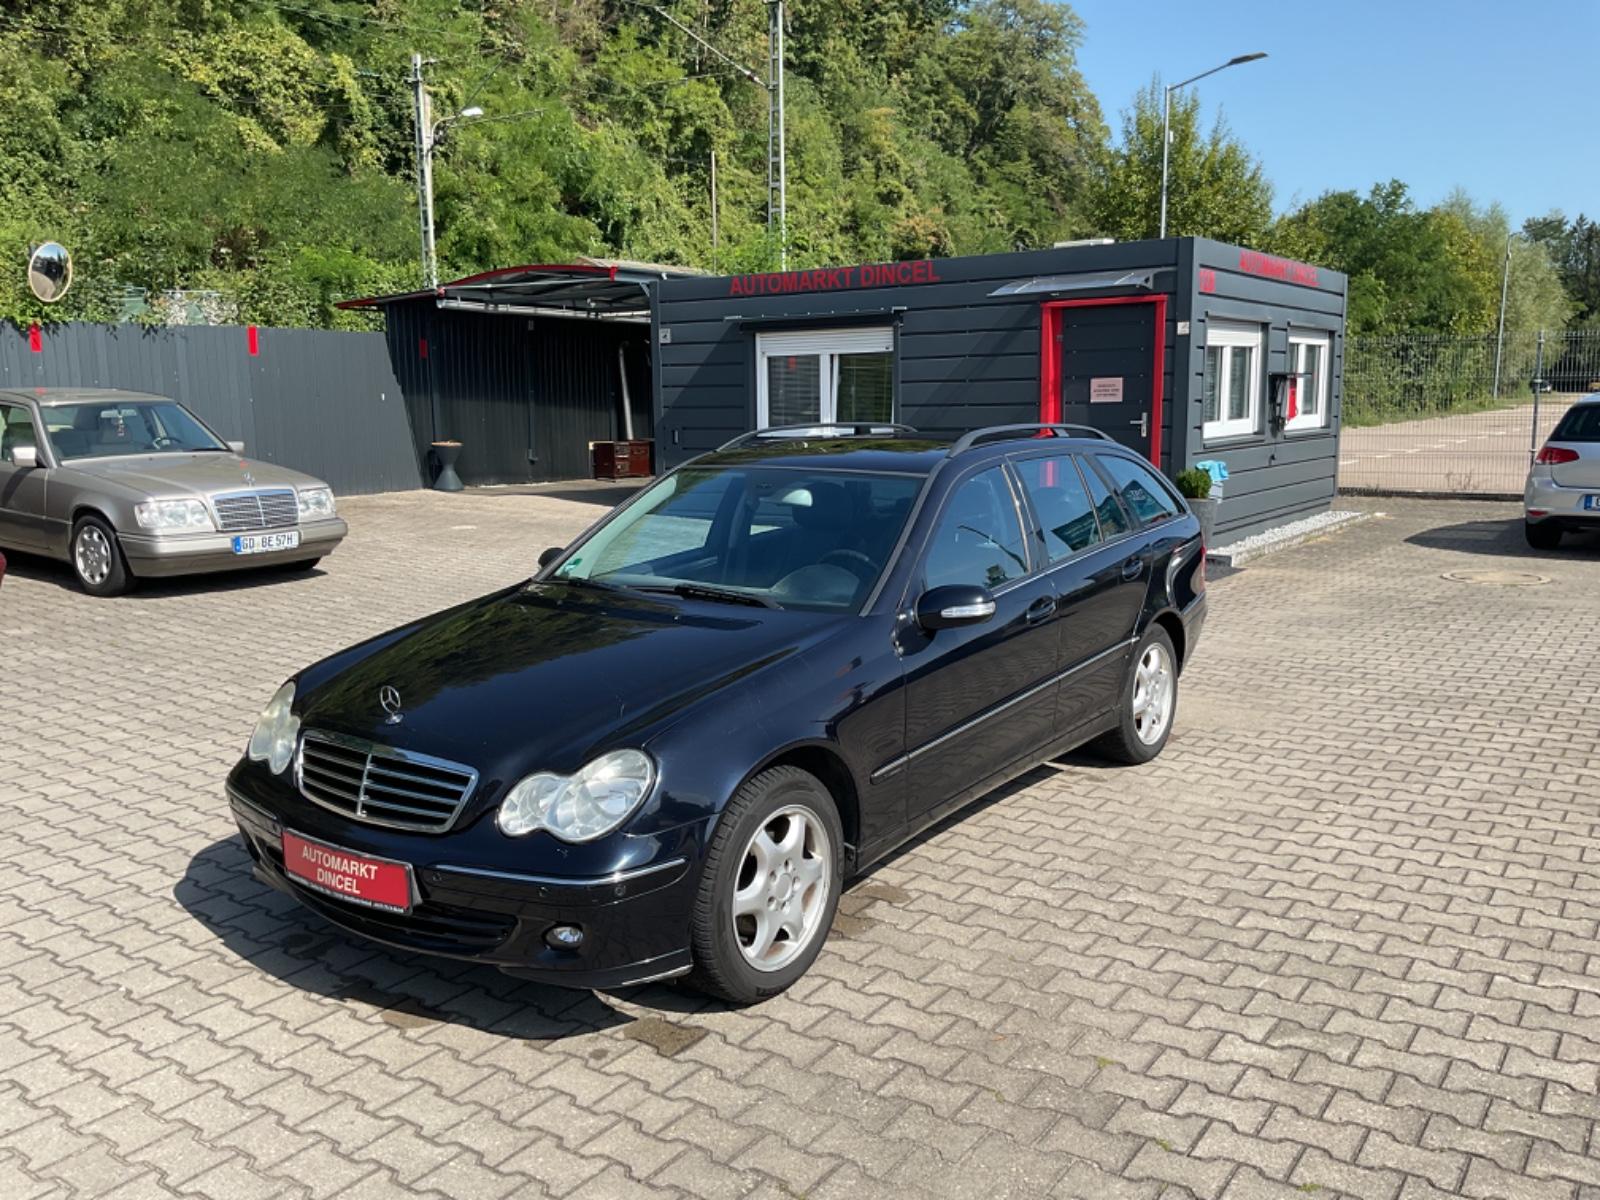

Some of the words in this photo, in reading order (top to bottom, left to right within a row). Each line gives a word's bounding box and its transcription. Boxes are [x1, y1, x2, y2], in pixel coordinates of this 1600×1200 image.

[730, 268, 854, 295] AUTOMARKT
[860, 260, 940, 288] DINCEL
[242, 537, 255, 550] GD
[261, 536, 274, 548] BE
[276, 533, 293, 545] 57H
[302, 845, 378, 880] AUTOMARKT
[317, 868, 361, 895] DINCEL
